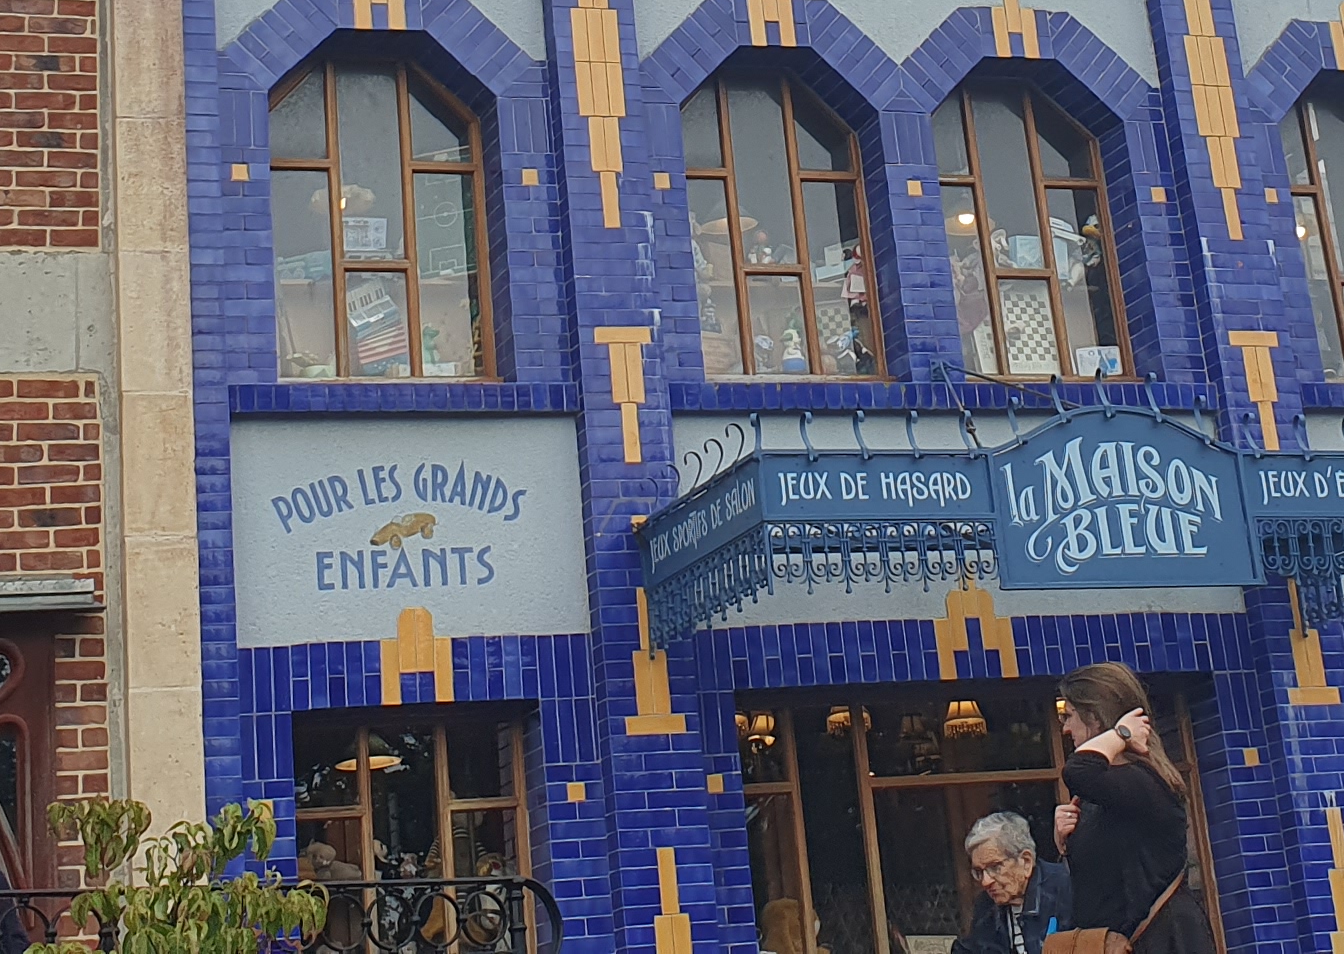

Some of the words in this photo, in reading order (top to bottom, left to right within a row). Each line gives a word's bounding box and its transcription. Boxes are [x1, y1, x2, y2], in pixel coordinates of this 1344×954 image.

[271, 475, 354, 533] POUR
[357, 464, 402, 506] LES
[414, 459, 527, 521] GRANDS
[778, 472, 832, 506] JEUX
[840, 472, 869, 500] DE
[880, 471, 971, 507] HASARD
[1000, 462, 1040, 527] la
[1025, 436, 1223, 562] MAISON
[1259, 471, 1310, 505] JEUX
[649, 531, 671, 574] JEUX
[710, 499, 723, 529] DE
[725, 478, 756, 521] SALON
[1055, 503, 1208, 575] BLEUE
[316, 545, 494, 590] ENFANTS
